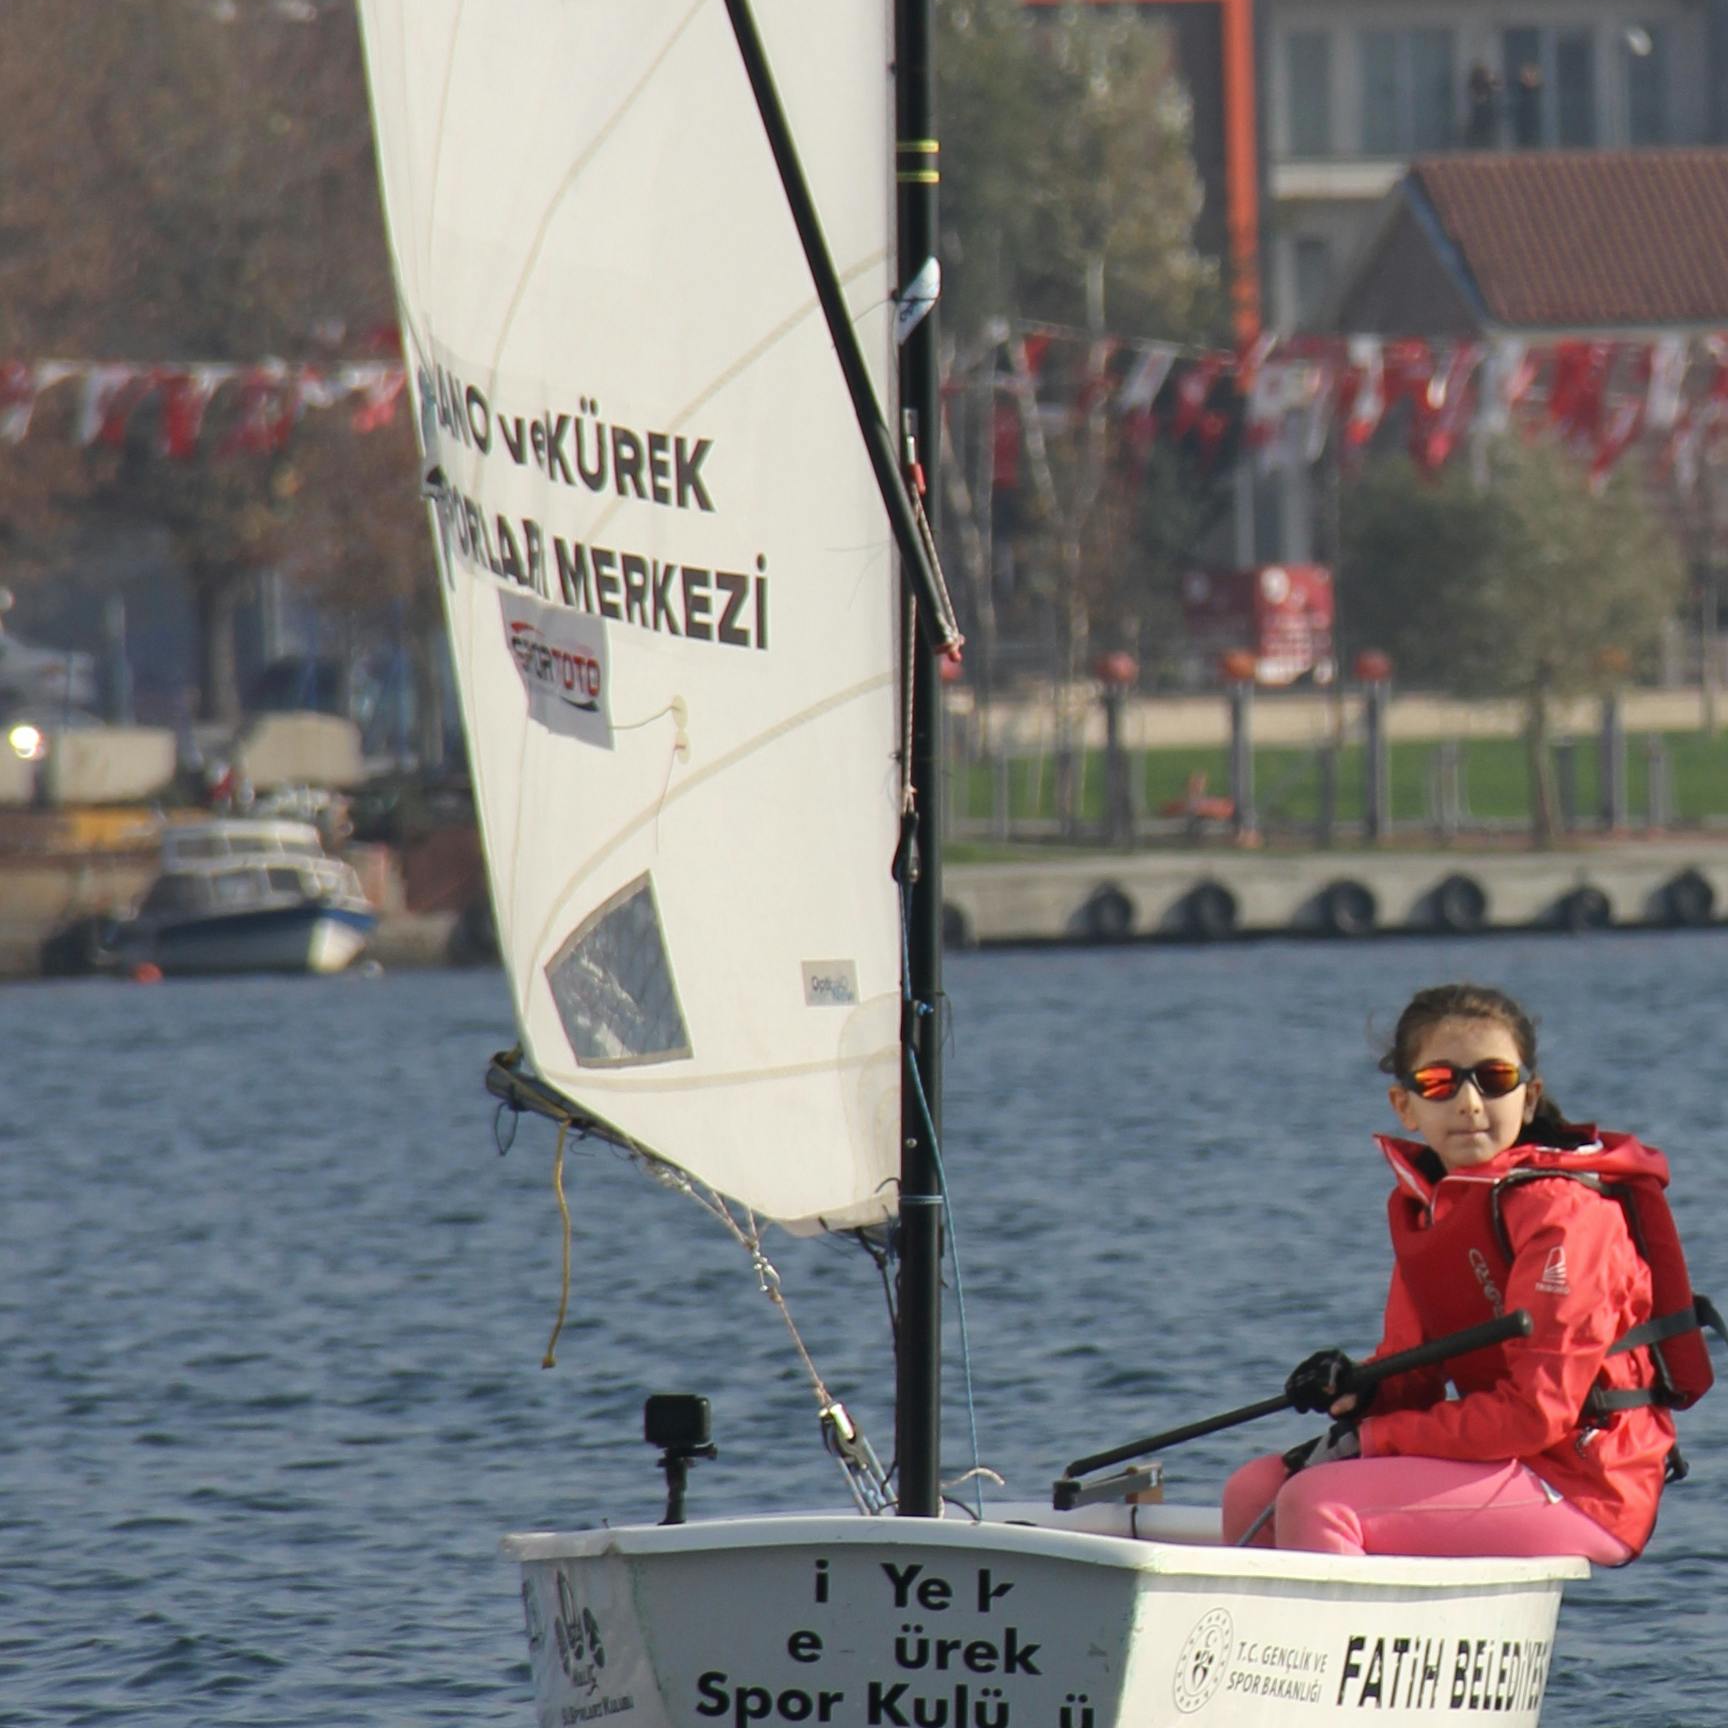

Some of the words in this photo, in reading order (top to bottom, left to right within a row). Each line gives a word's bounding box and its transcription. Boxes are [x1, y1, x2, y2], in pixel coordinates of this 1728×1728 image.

[497, 411, 546, 471] ve
[546, 394, 716, 513] KÜREK
[553, 534, 769, 651] MERKEZİ
[1226, 1670, 1262, 1695] SPOR
[1313, 1652, 1329, 1674] VE
